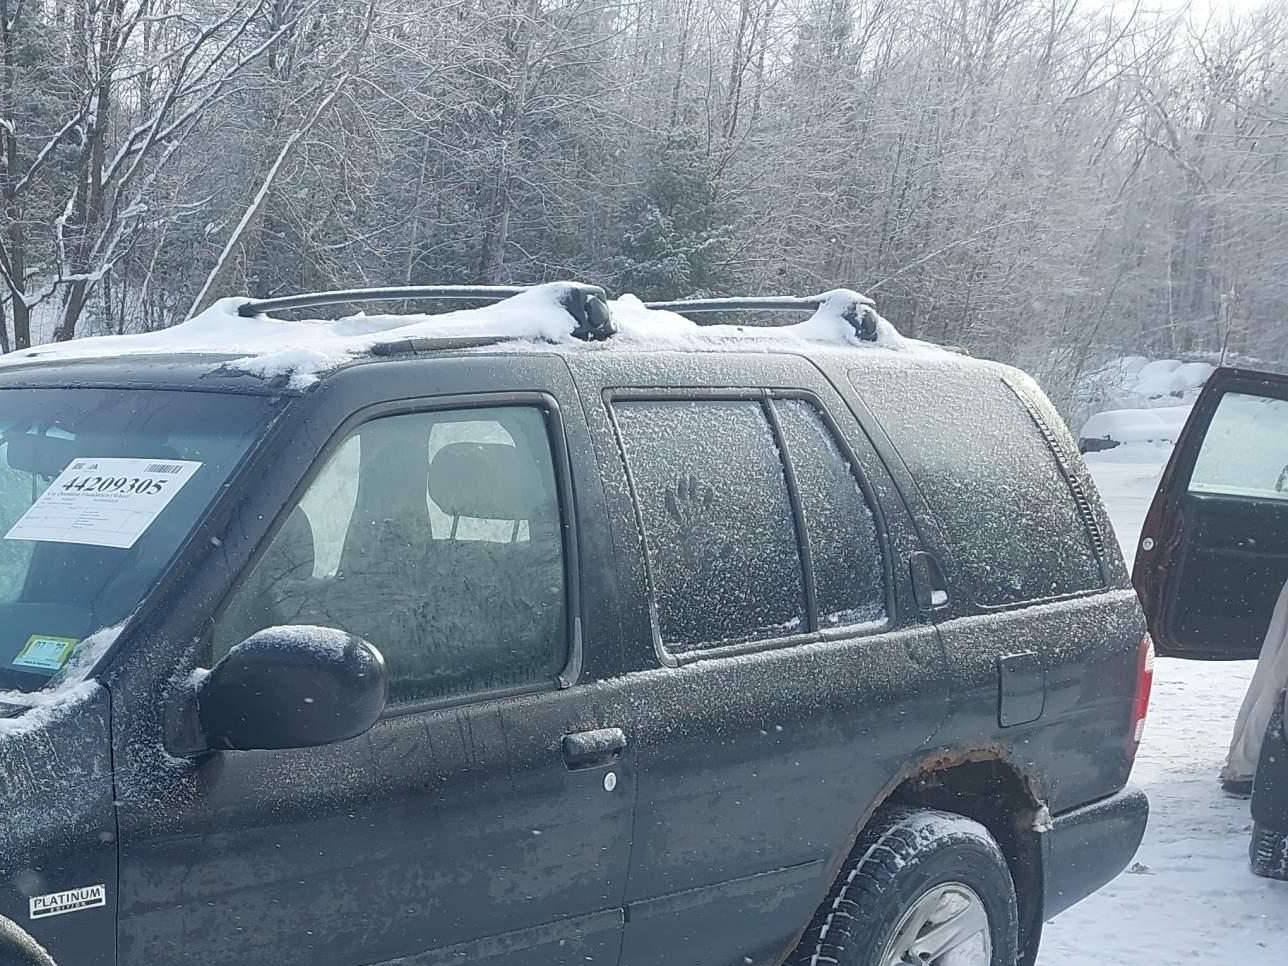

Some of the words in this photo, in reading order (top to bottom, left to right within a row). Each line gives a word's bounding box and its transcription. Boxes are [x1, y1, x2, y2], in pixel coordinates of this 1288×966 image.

[62, 476, 169, 495] 44209305
[34, 888, 101, 909] PLATINUM
[50, 902, 87, 913] EDITION
